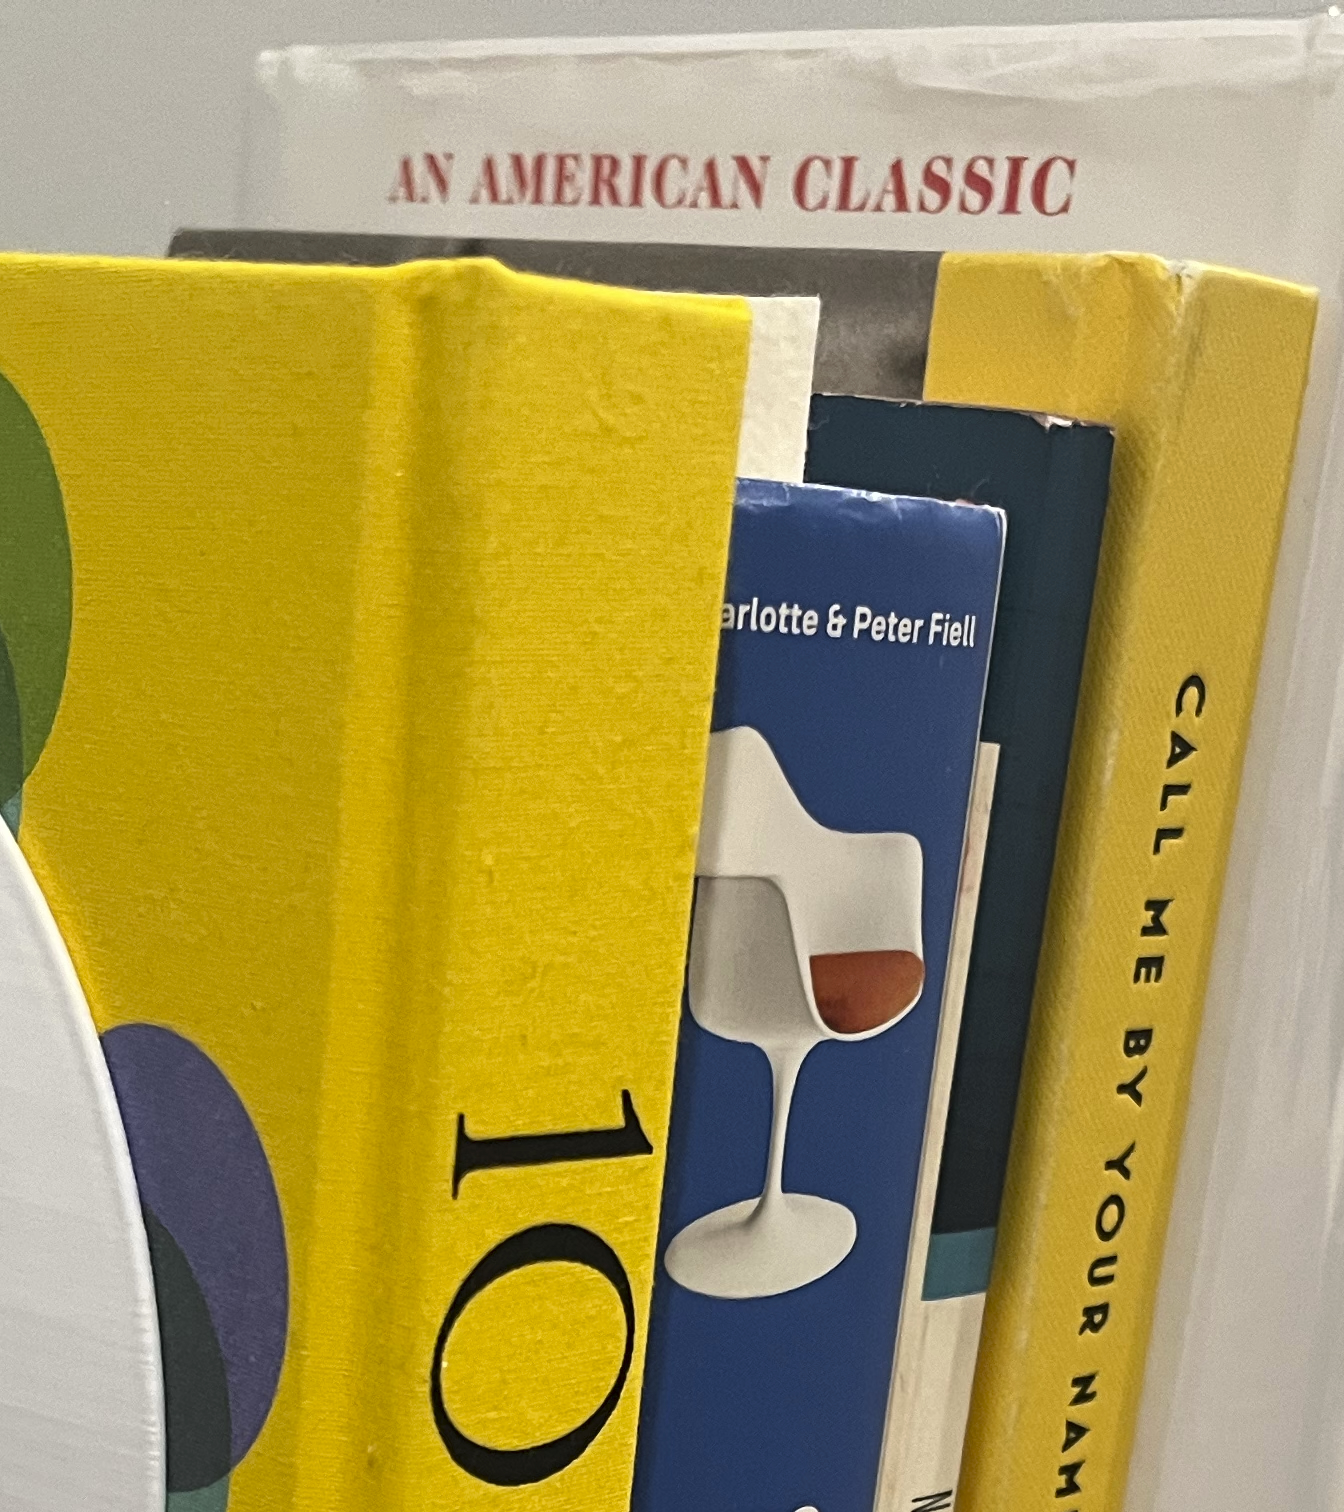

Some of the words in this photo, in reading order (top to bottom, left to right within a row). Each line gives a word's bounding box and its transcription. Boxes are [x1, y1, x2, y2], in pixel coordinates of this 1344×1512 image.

[388, 152, 454, 204] AN
[469, 152, 772, 211] AMERICAN
[792, 154, 1078, 217] CLASSIC
[720, 596, 819, 636] arlotte
[826, 603, 848, 639] &
[852, 605, 924, 644] Peter
[928, 610, 977, 648] Fiell
[1153, 674, 1207, 856] CALL
[1132, 898, 1176, 985] ME
[1116, 1027, 1154, 1108] BY
[1078, 1140, 1137, 1337] YOUR
